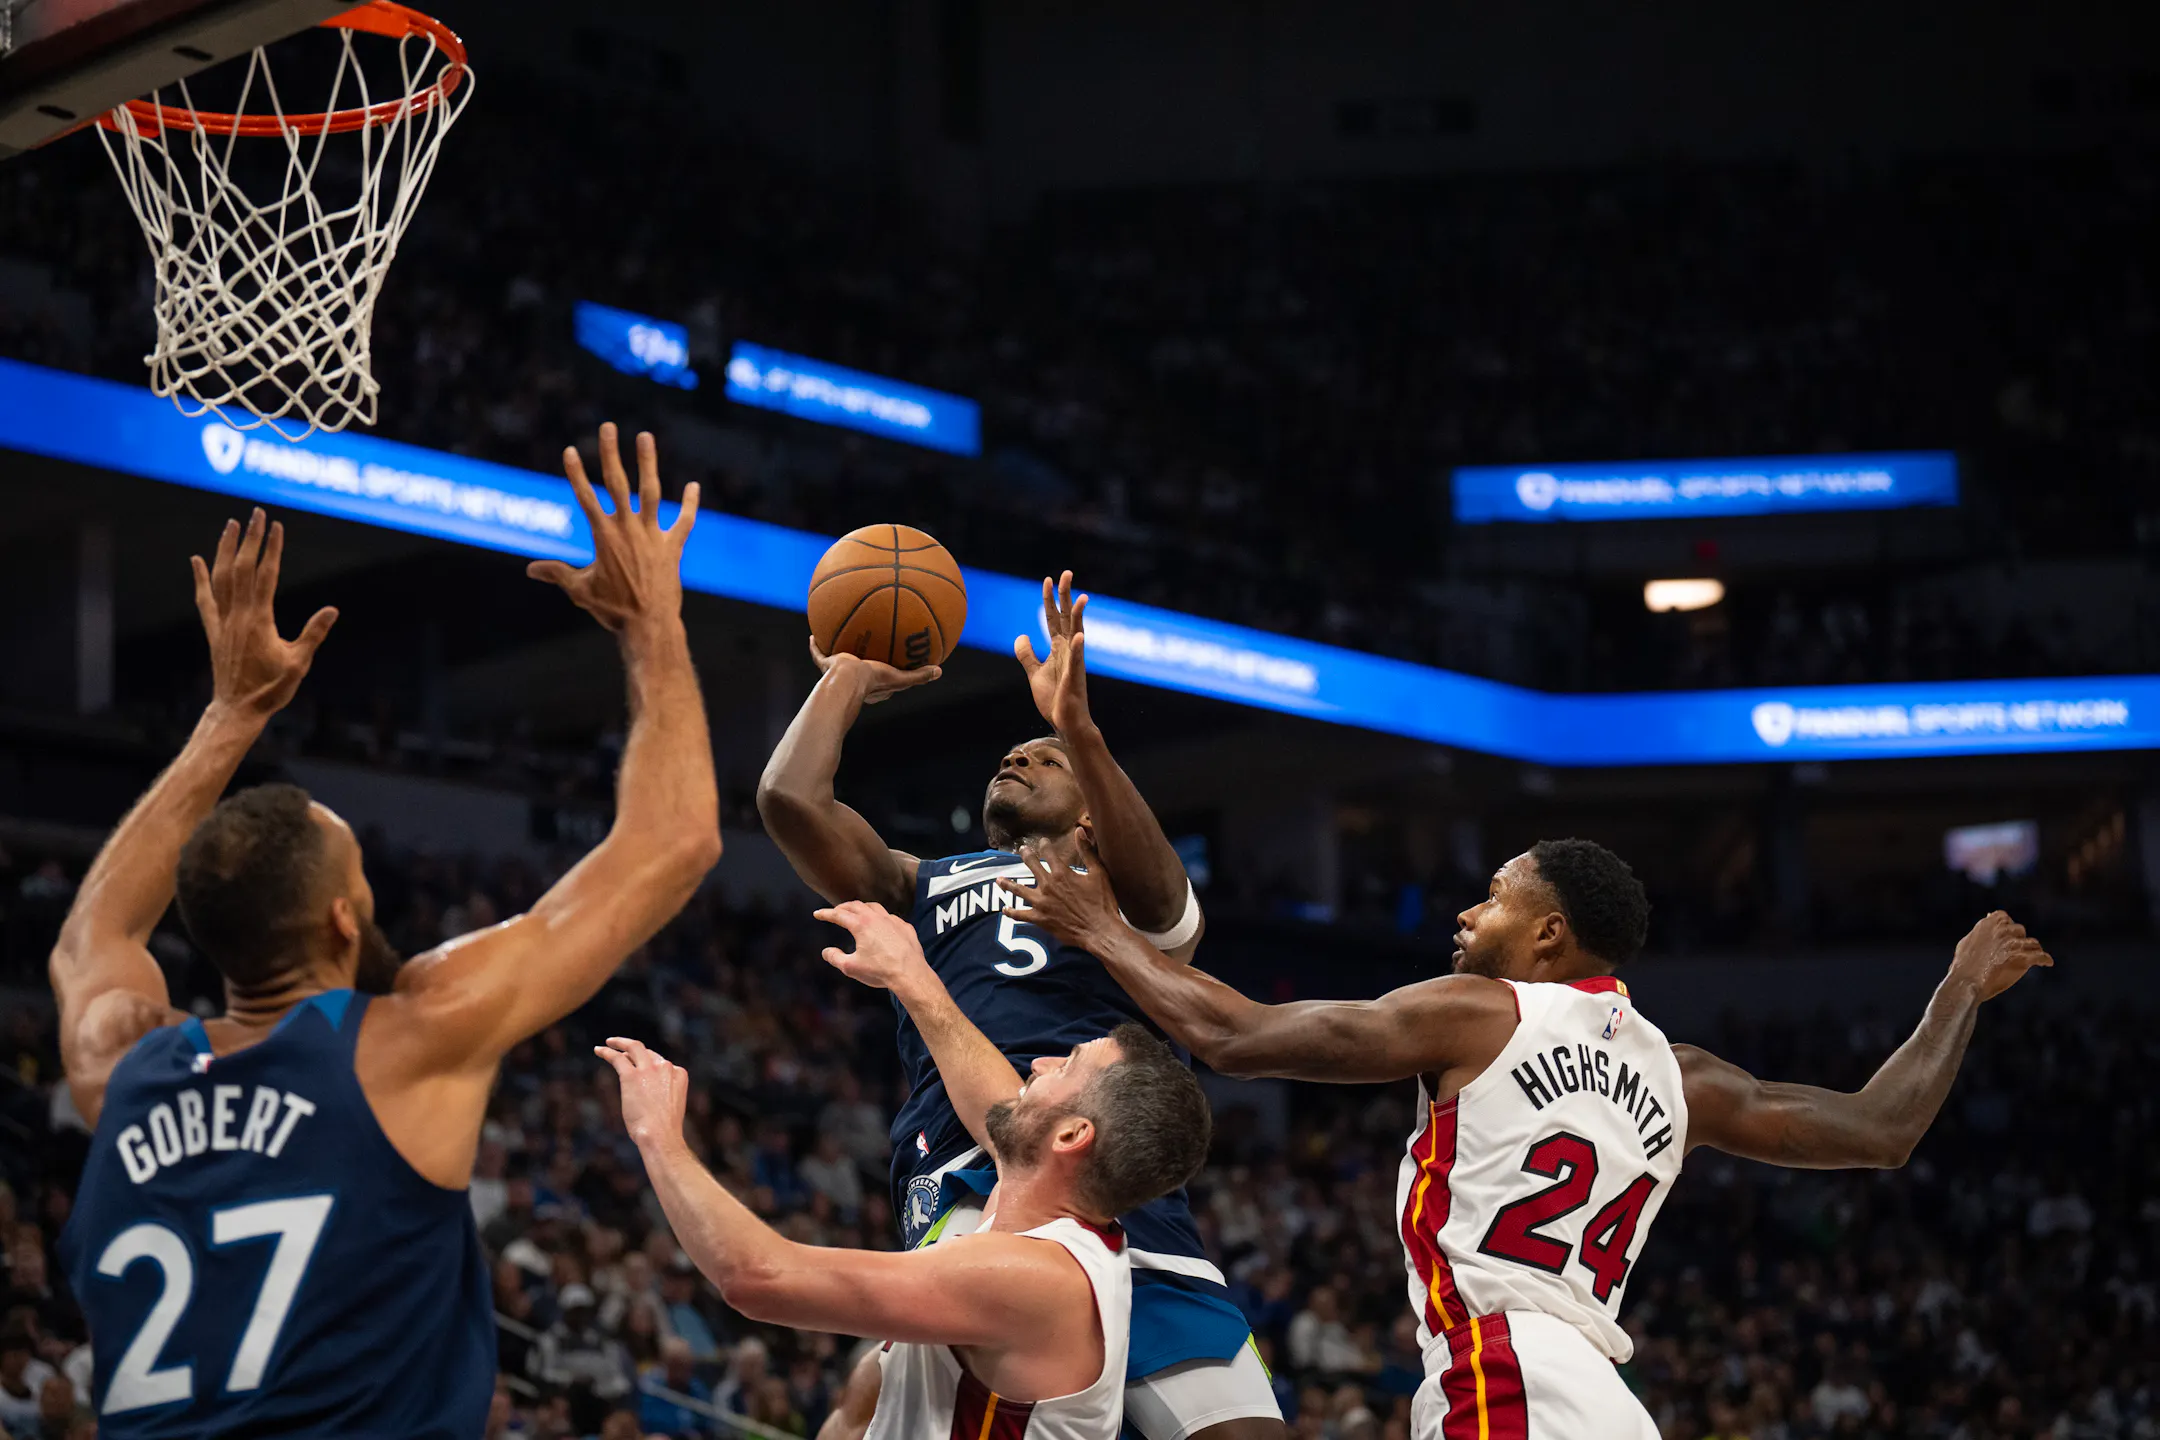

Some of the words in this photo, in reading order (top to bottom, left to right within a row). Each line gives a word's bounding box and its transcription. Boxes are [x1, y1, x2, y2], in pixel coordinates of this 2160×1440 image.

[993, 914, 1048, 976] 5
[117, 1084, 317, 1184] GOBERT
[1511, 1044, 1673, 1161] HIGHSMITH
[1477, 1131, 1660, 1306] 24
[97, 1194, 335, 1416] 27
